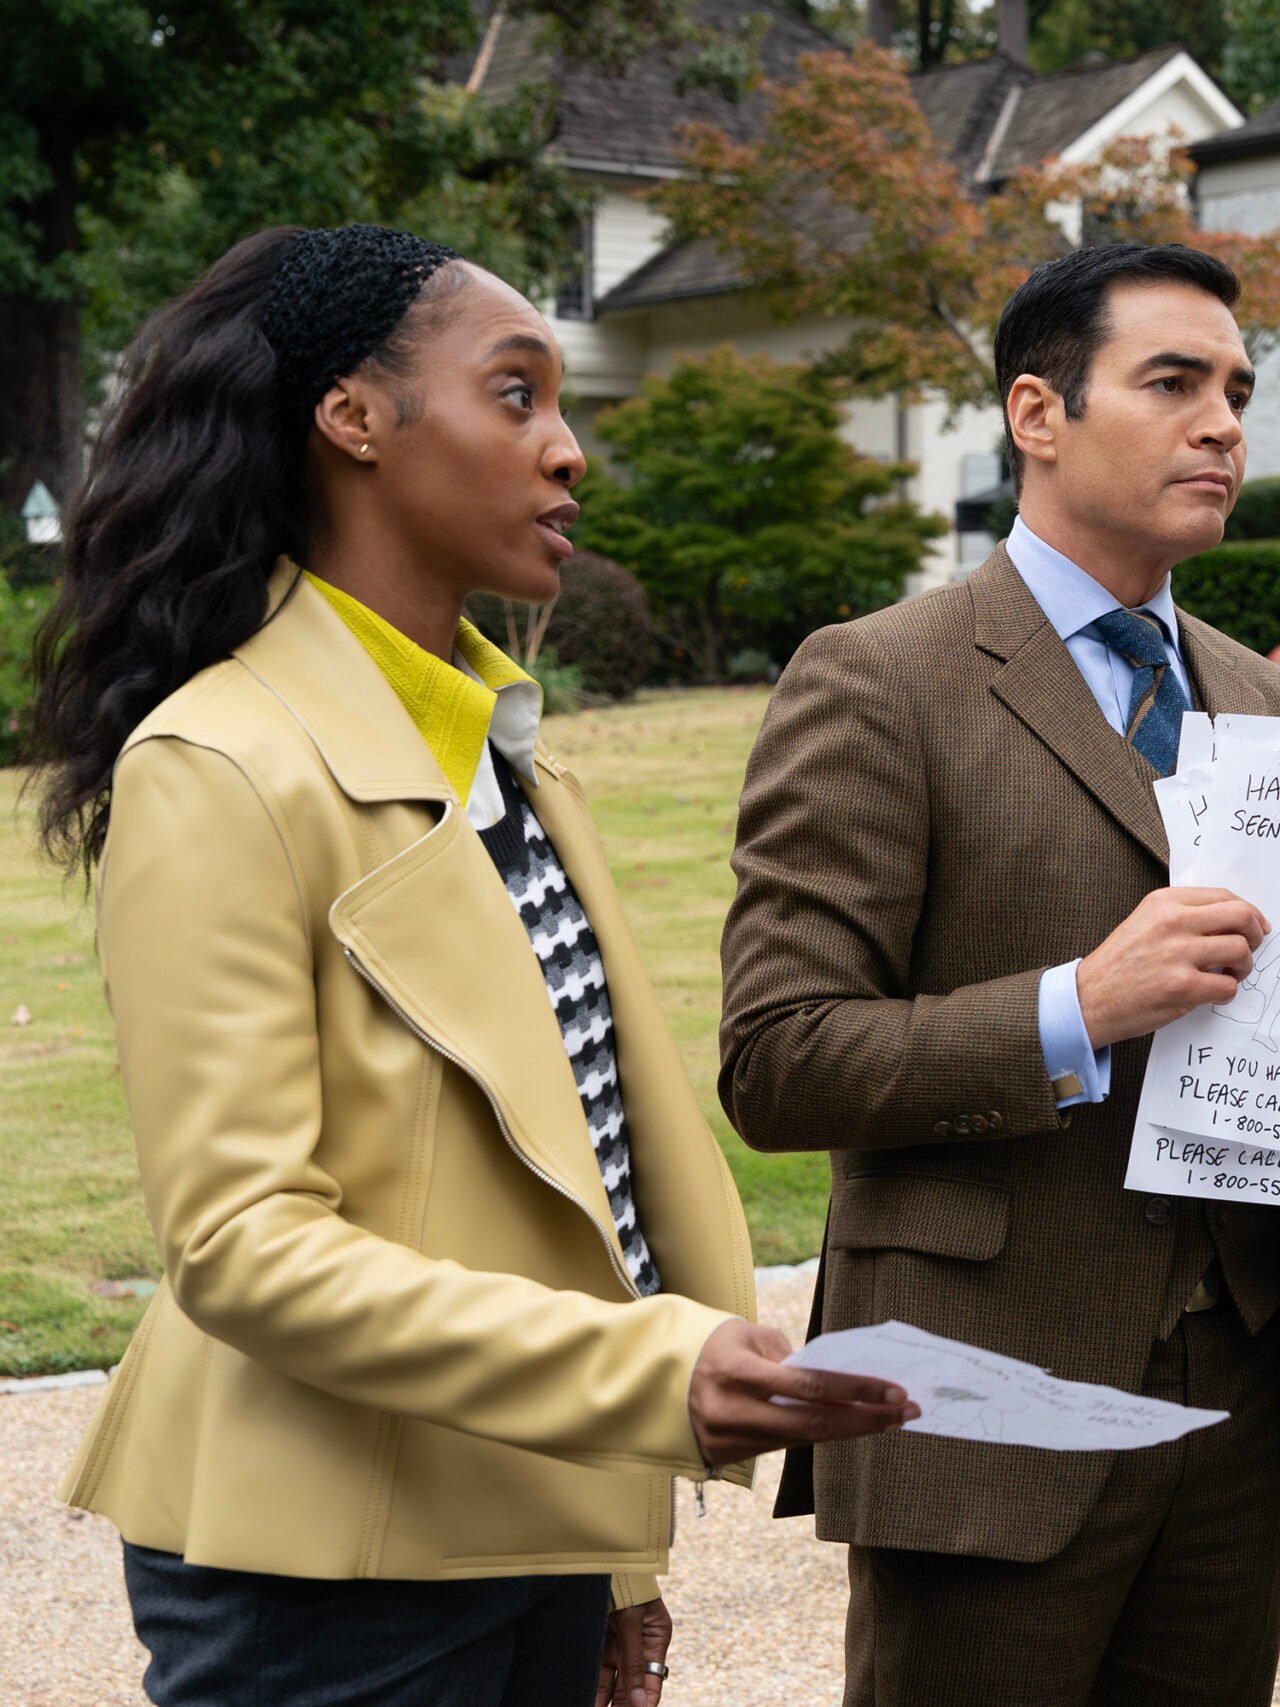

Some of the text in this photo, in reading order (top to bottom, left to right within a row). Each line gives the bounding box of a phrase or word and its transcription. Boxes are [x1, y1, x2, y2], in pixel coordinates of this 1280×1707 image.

[1230, 809, 1280, 838] SEEN
[1188, 1044, 1213, 1066] IF
[1226, 1055, 1259, 1077] YOU
[1180, 1075, 1249, 1108] PLEASE
[1156, 1137, 1229, 1167] PLEASE
